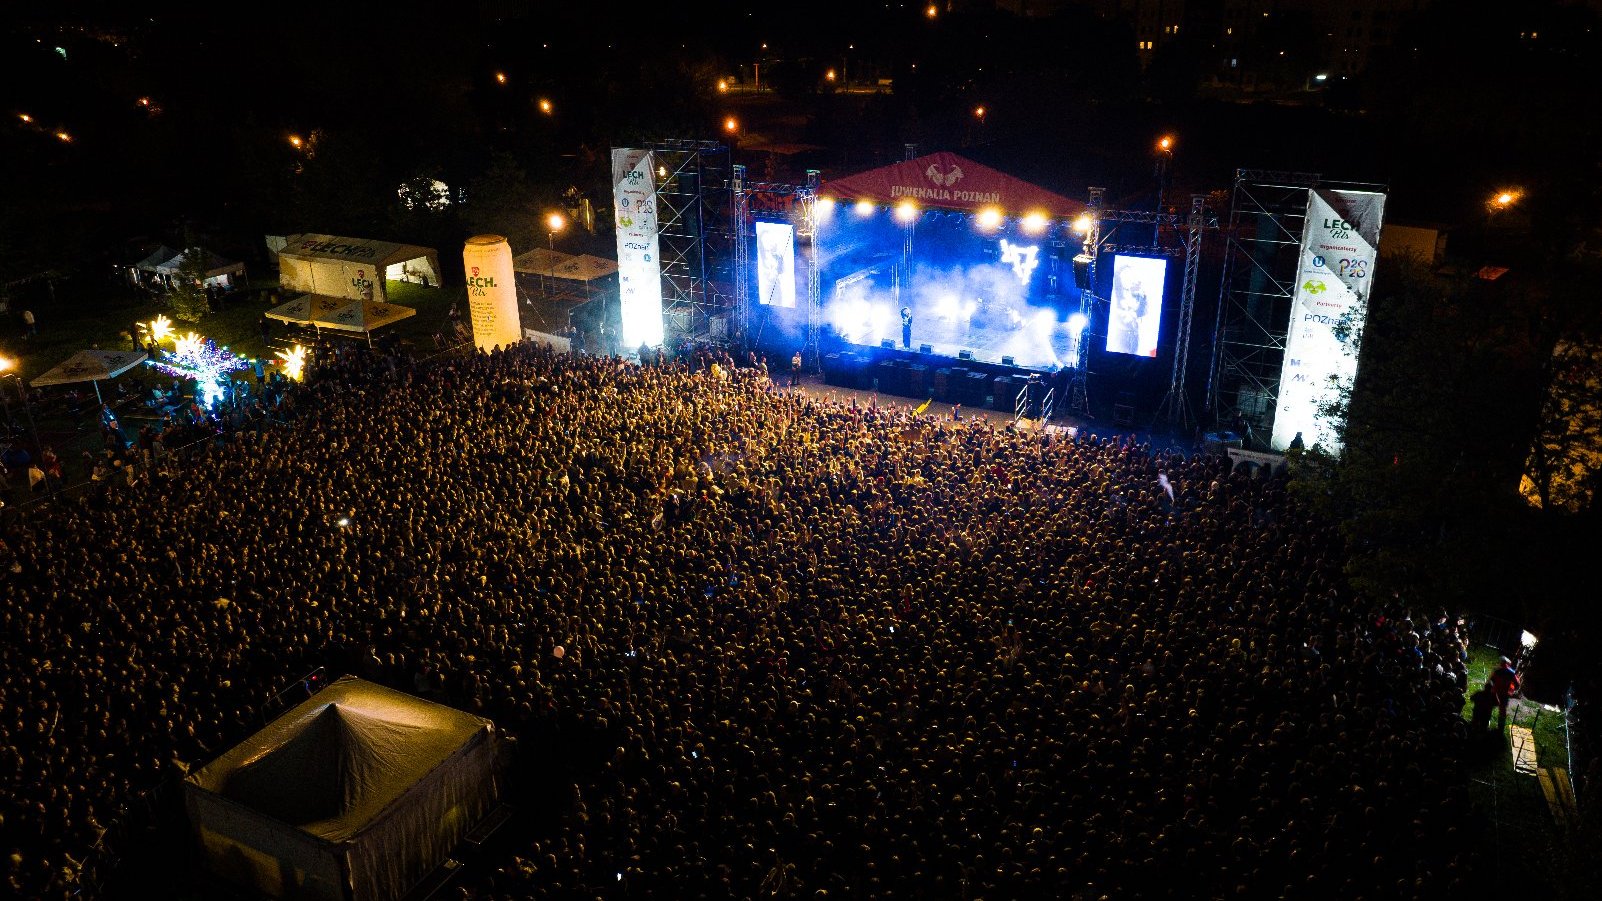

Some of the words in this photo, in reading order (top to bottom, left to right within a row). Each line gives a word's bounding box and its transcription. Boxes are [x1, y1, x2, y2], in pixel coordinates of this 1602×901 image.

[623, 170, 644, 180] LECH
[890, 185, 951, 201] JUWENALIA
[953, 189, 1000, 203] POZNAŃ
[1323, 218, 1361, 232] LECH
